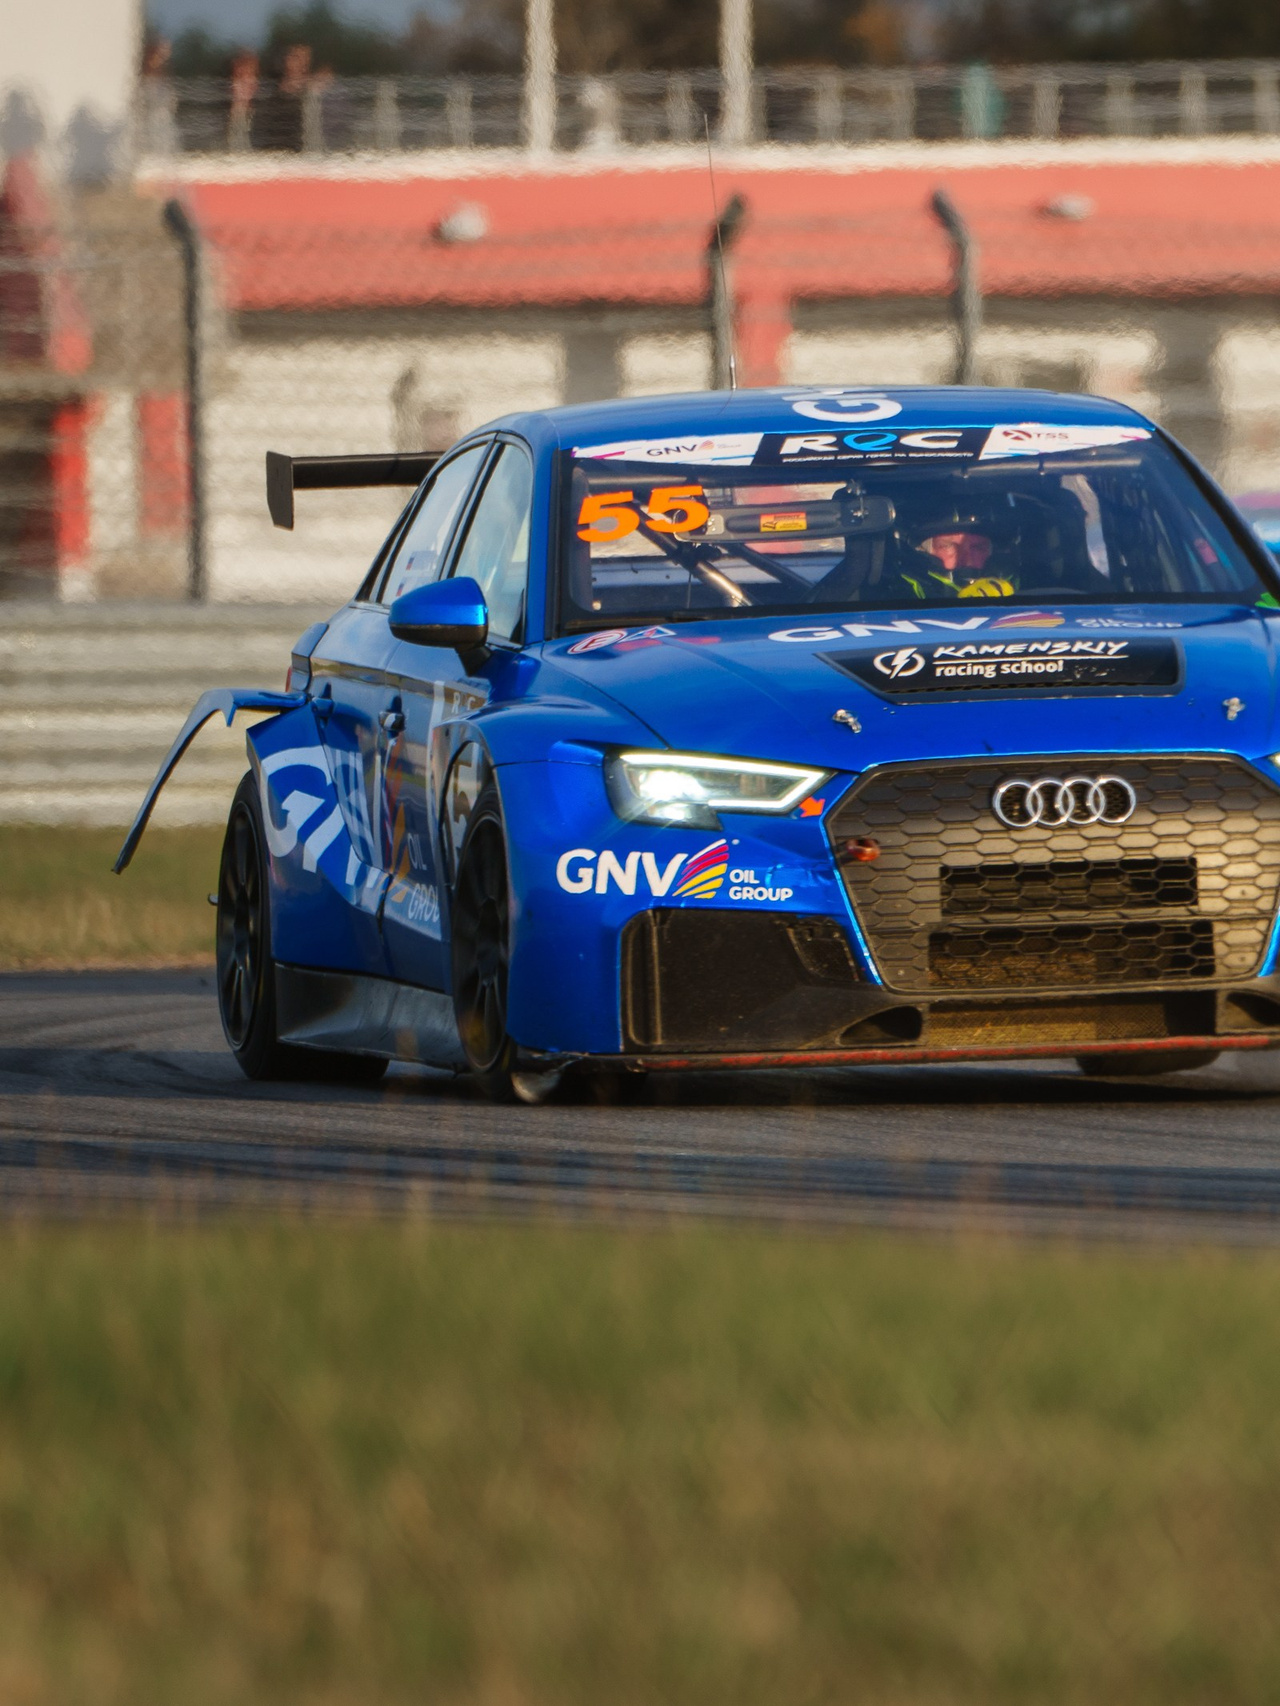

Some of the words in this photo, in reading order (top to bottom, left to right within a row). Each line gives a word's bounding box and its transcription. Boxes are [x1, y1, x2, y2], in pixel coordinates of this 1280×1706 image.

[1035, 432, 1069, 440] TSS
[646, 443, 698, 457] GNV
[576, 485, 710, 543] 55
[767, 616, 991, 643] GNV
[933, 640, 1129, 658] KAMENSKIY
[934, 660, 997, 679] racing
[1000, 659, 1064, 675] school
[407, 832, 428, 871] OIL
[556, 848, 689, 897] GNV
[729, 868, 760, 885] OIL
[407, 880, 441, 923] GROU
[728, 886, 794, 901] GROUP
